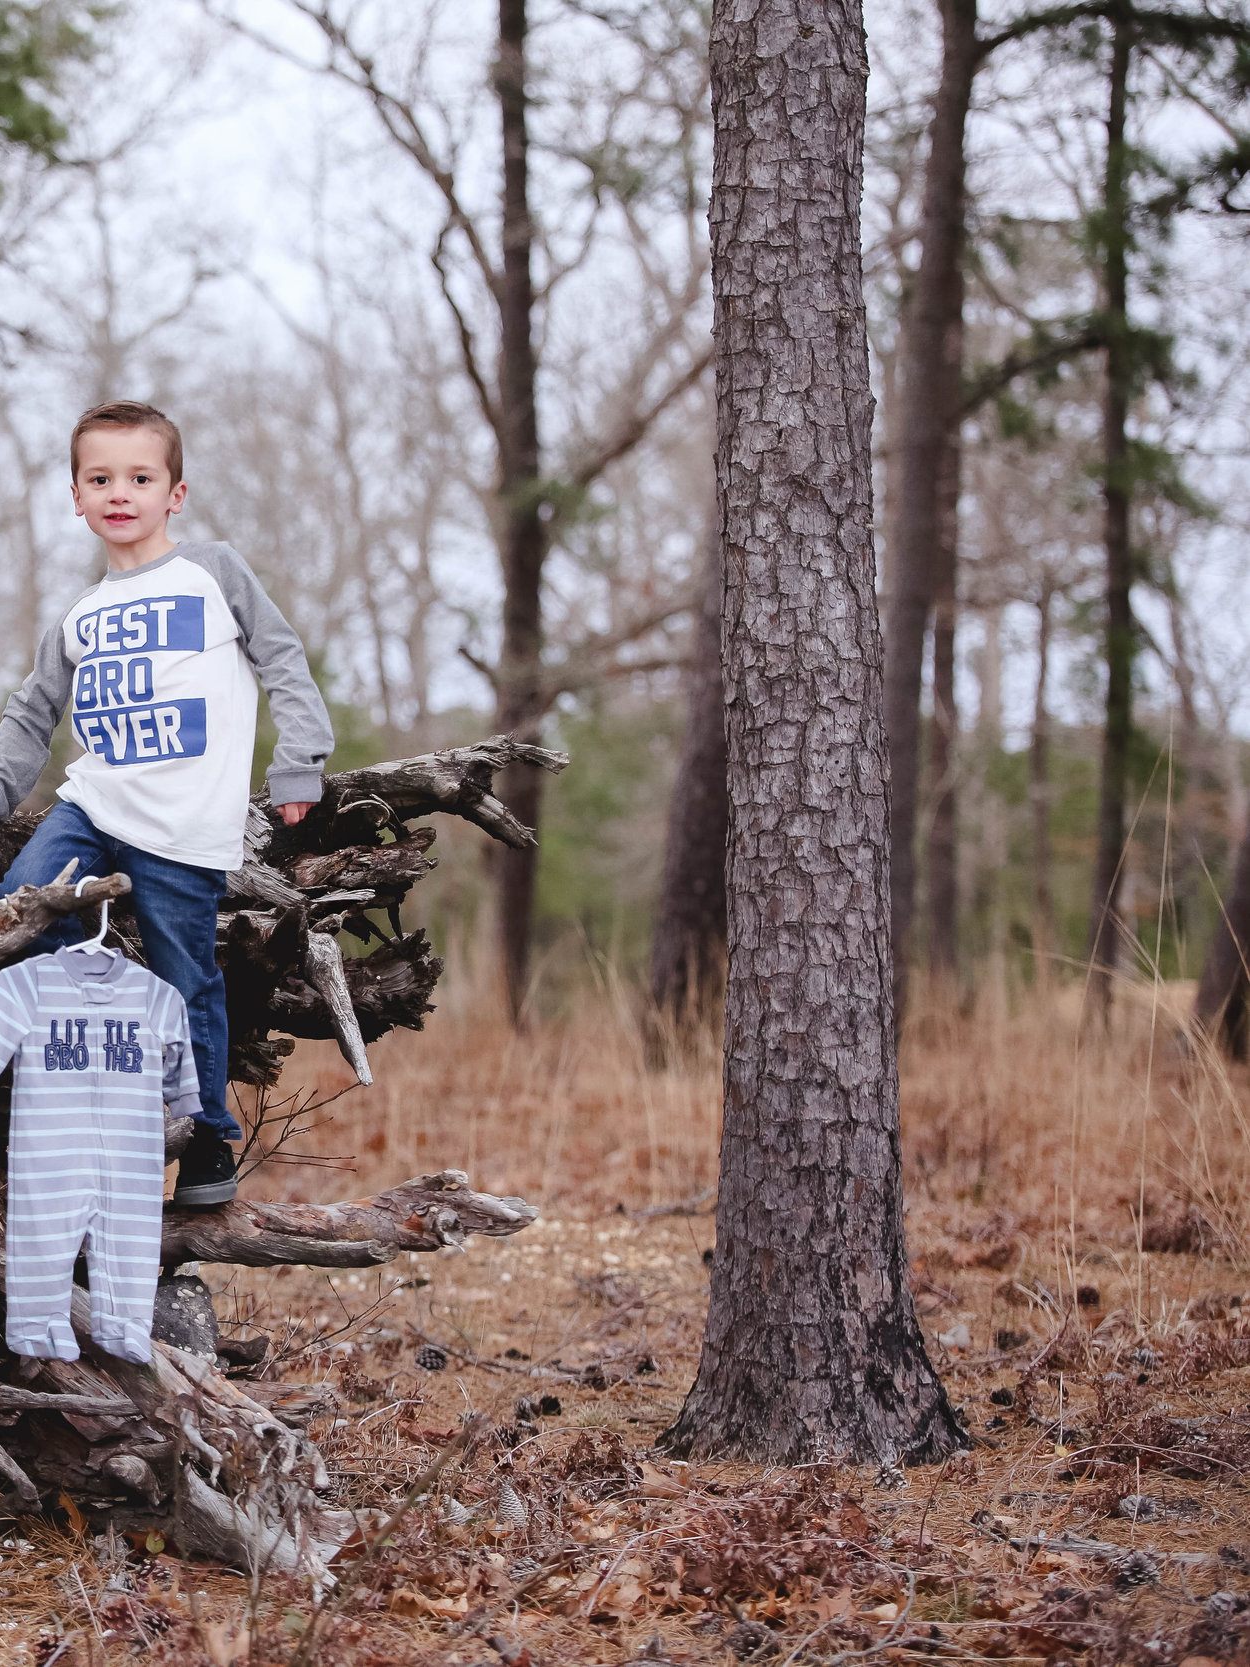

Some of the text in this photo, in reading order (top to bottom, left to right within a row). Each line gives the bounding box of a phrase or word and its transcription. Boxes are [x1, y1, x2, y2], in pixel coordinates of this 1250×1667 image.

[80, 601, 176, 653] BEST
[75, 657, 154, 710] BRO
[79, 706, 185, 760] EVER
